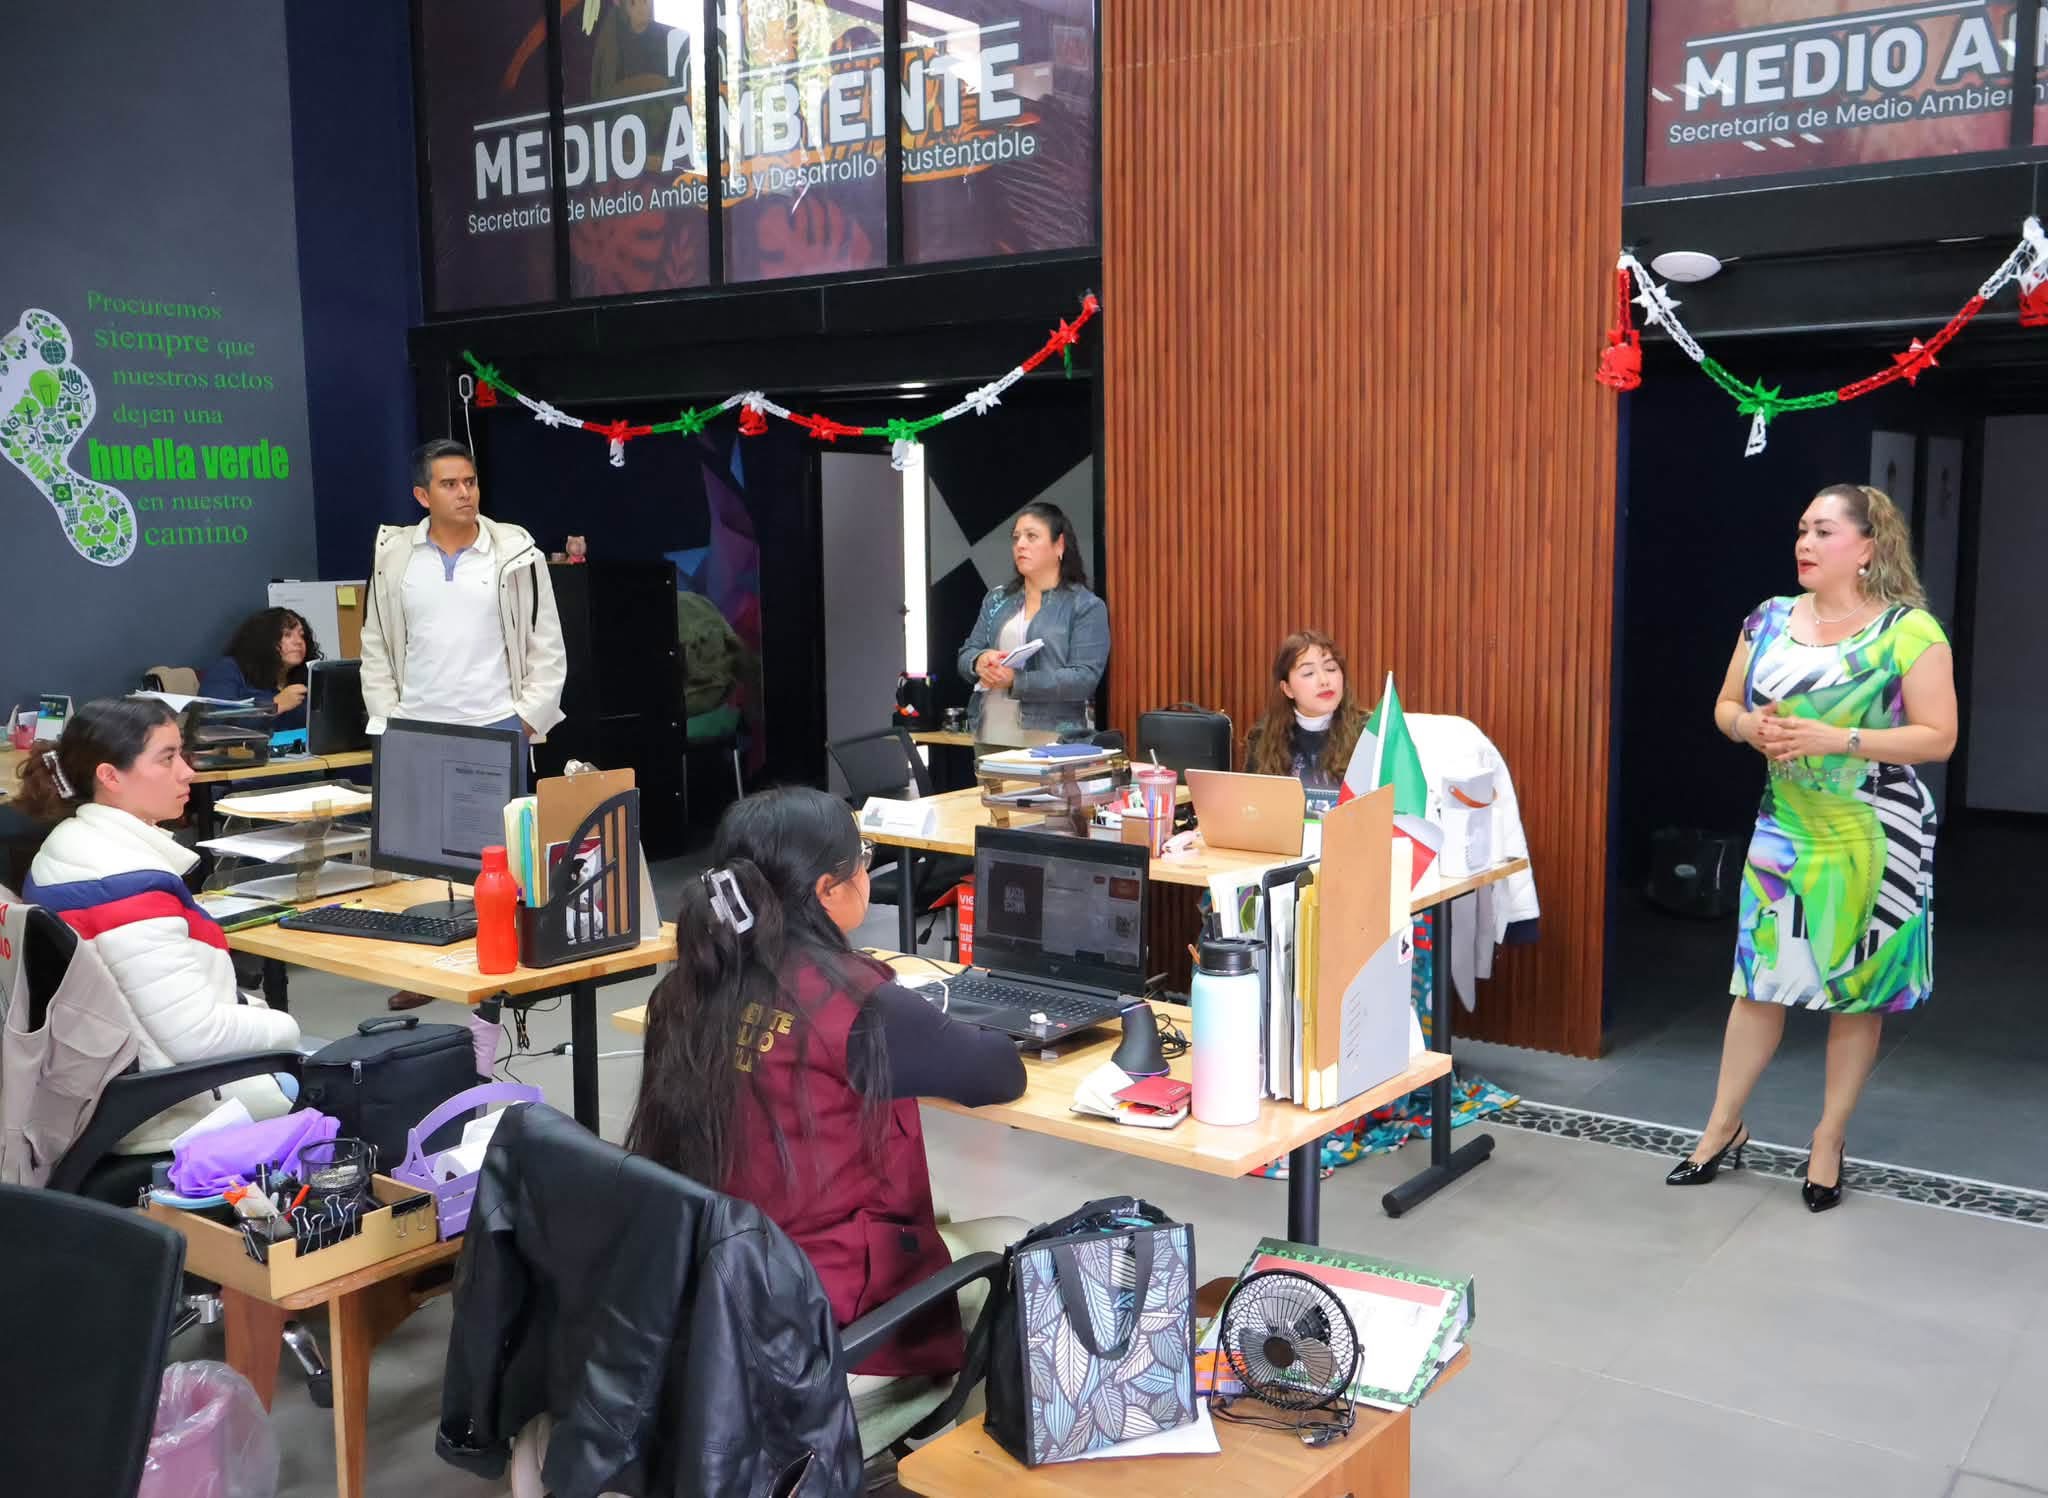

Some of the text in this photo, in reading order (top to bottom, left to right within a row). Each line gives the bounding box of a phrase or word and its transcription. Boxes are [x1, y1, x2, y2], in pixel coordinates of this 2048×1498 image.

[1685, 26, 1923, 112] MEDIO
[475, 43, 1022, 200] MEDIO AMBIENTE
[1668, 81, 2048, 144] Secretaría de Medio Ambien
[468, 203, 551, 234] Secretaría
[590, 190, 644, 217] Medio
[649, 173, 747, 210] Ambiente
[752, 174, 767, 200] y
[770, 154, 877, 190] Desarrollo
[88, 290, 223, 320] Procuremos
[95, 322, 256, 359] siempre que
[113, 369, 274, 390] nuestros actos
[113, 403, 224, 429] dejen una
[88, 438, 289, 481] huella verde
[137, 494, 253, 511] en nuestro
[144, 518, 249, 546] camino
